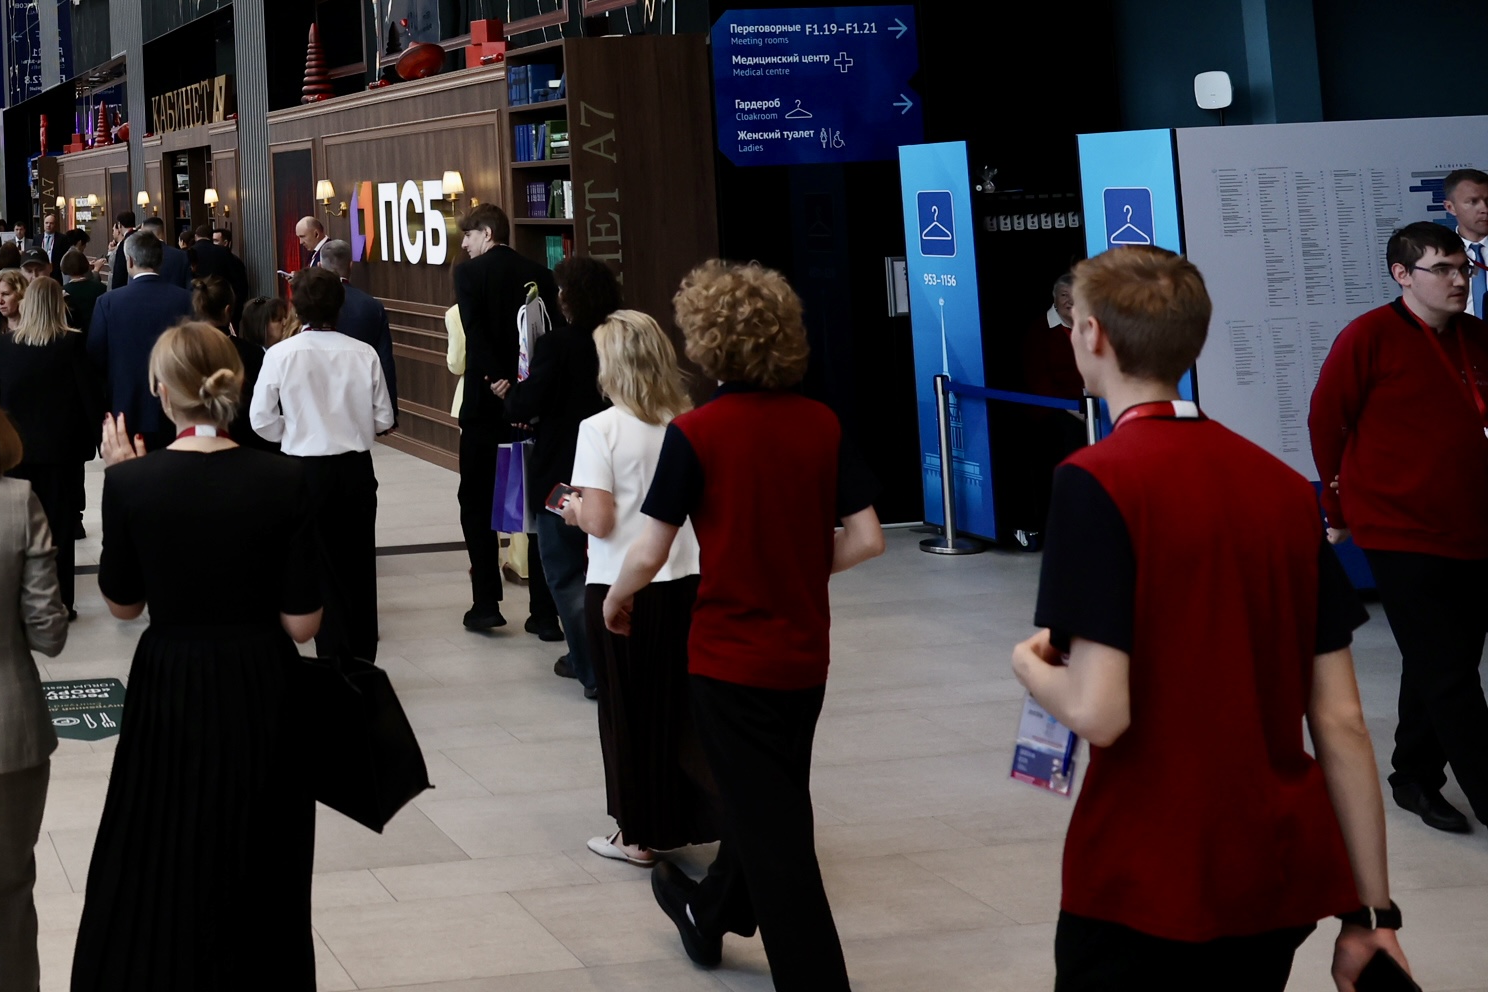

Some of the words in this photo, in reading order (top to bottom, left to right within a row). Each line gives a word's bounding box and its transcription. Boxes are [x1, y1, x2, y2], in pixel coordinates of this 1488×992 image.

[730, 23, 801, 35] Переговорные
[731, 36, 763, 46] Meeting
[764, 36, 789, 44] rooms
[732, 53, 799, 66] Медицинский
[801, 53, 830, 63] центр
[733, 67, 763, 76] Medical
[765, 67, 790, 75] centre
[151, 79, 210, 136] КАБИНЕТ
[735, 98, 781, 111] Гардероб
[735, 112, 778, 121] Cloakroom
[737, 129, 781, 140] Женский
[782, 129, 815, 140] туалет
[738, 143, 764, 152] Ladies
[377, 179, 447, 265] ПСБ
[46, 688, 110, 696] «ФОРУ
